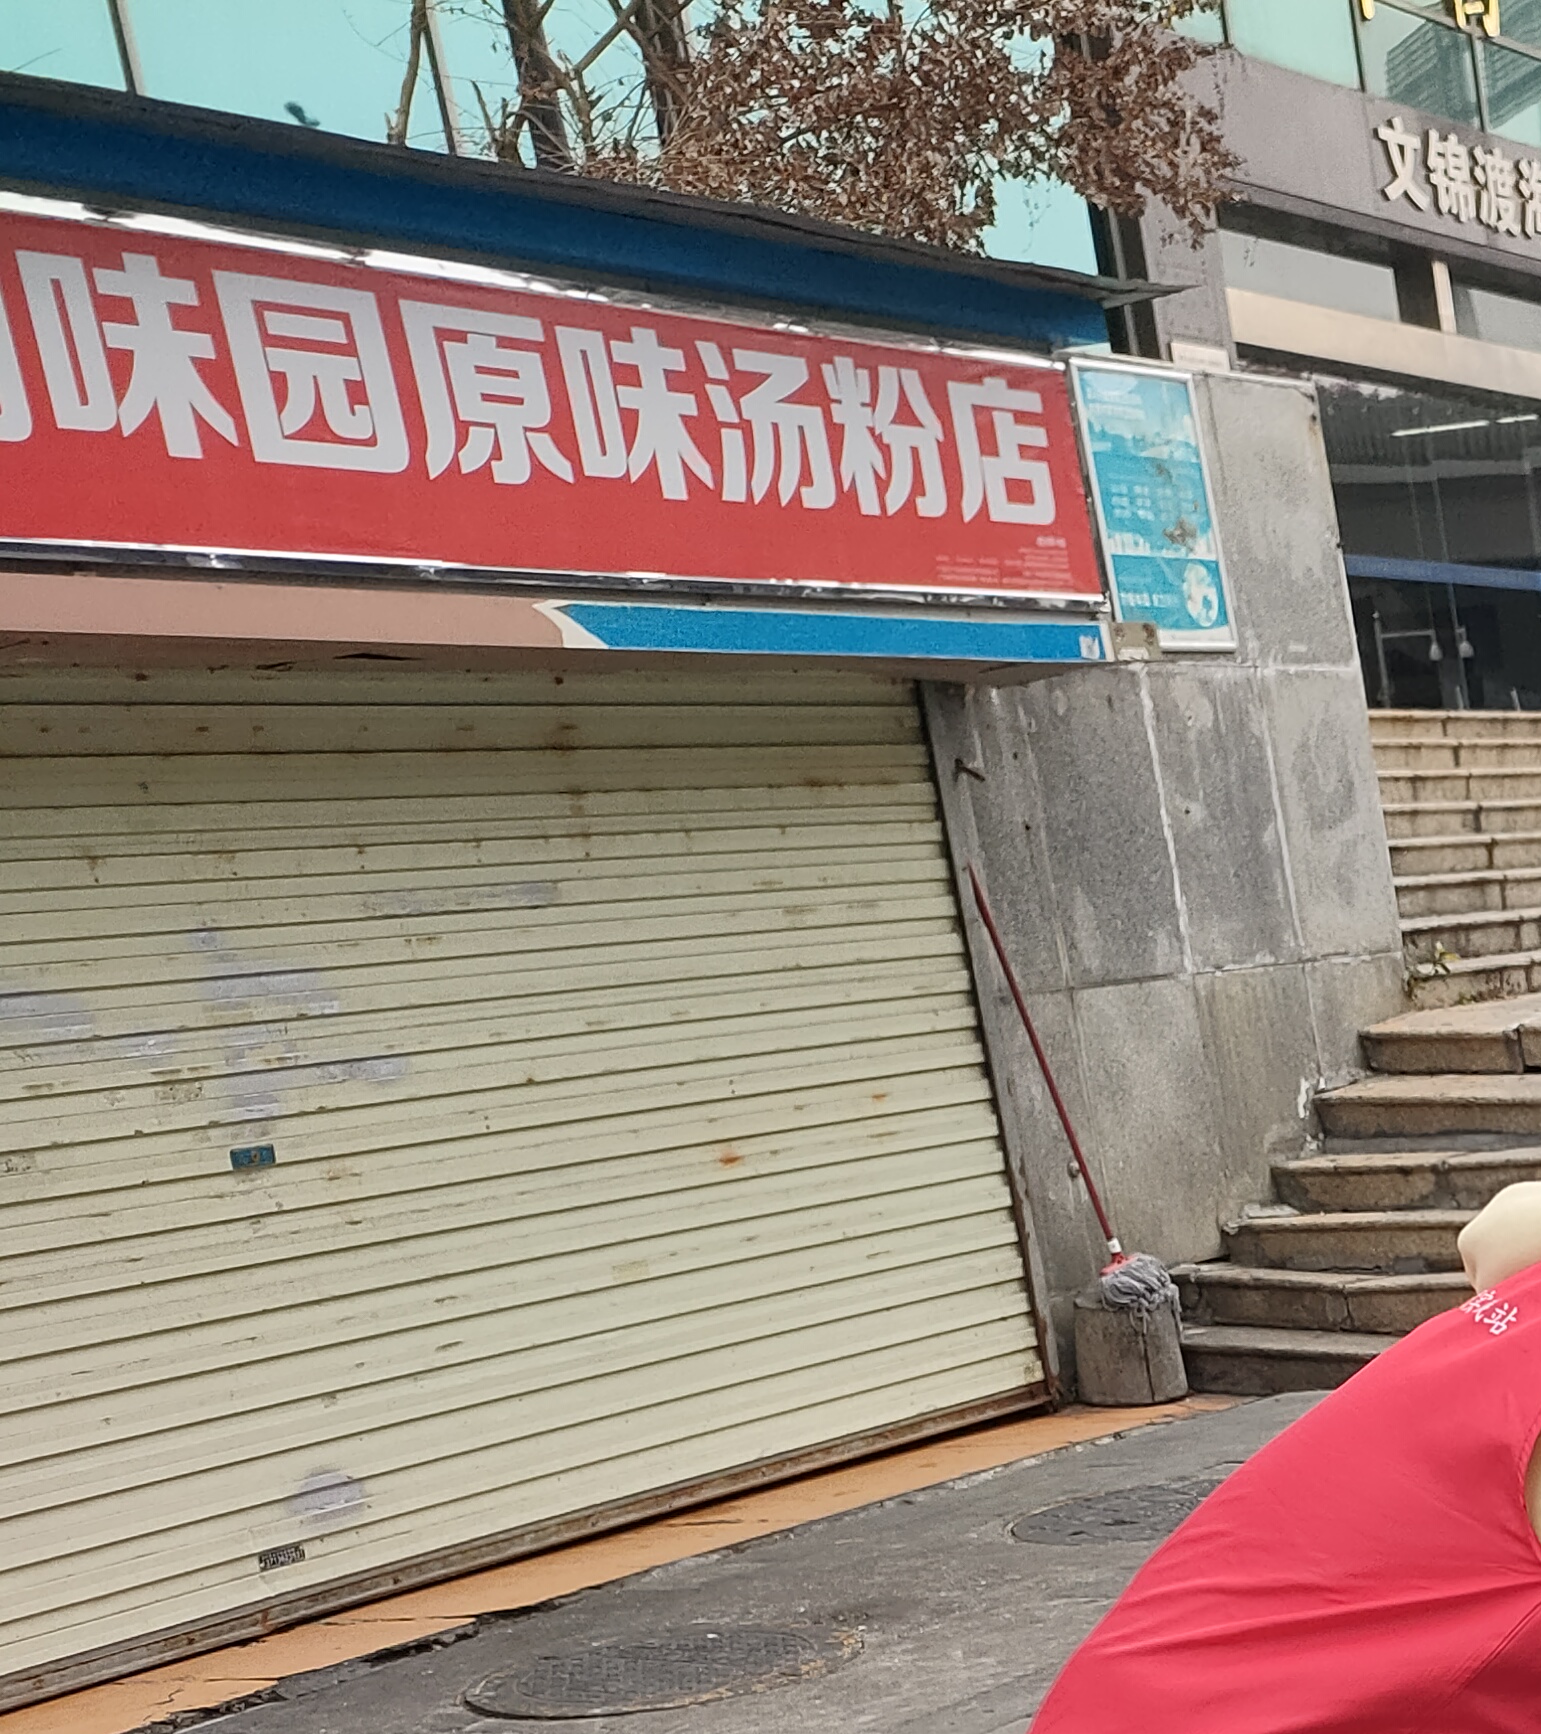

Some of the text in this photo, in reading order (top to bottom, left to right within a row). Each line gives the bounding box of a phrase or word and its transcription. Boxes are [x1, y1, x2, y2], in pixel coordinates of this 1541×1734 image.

[0, 250, 1058, 525] 味园原味汤粉店
